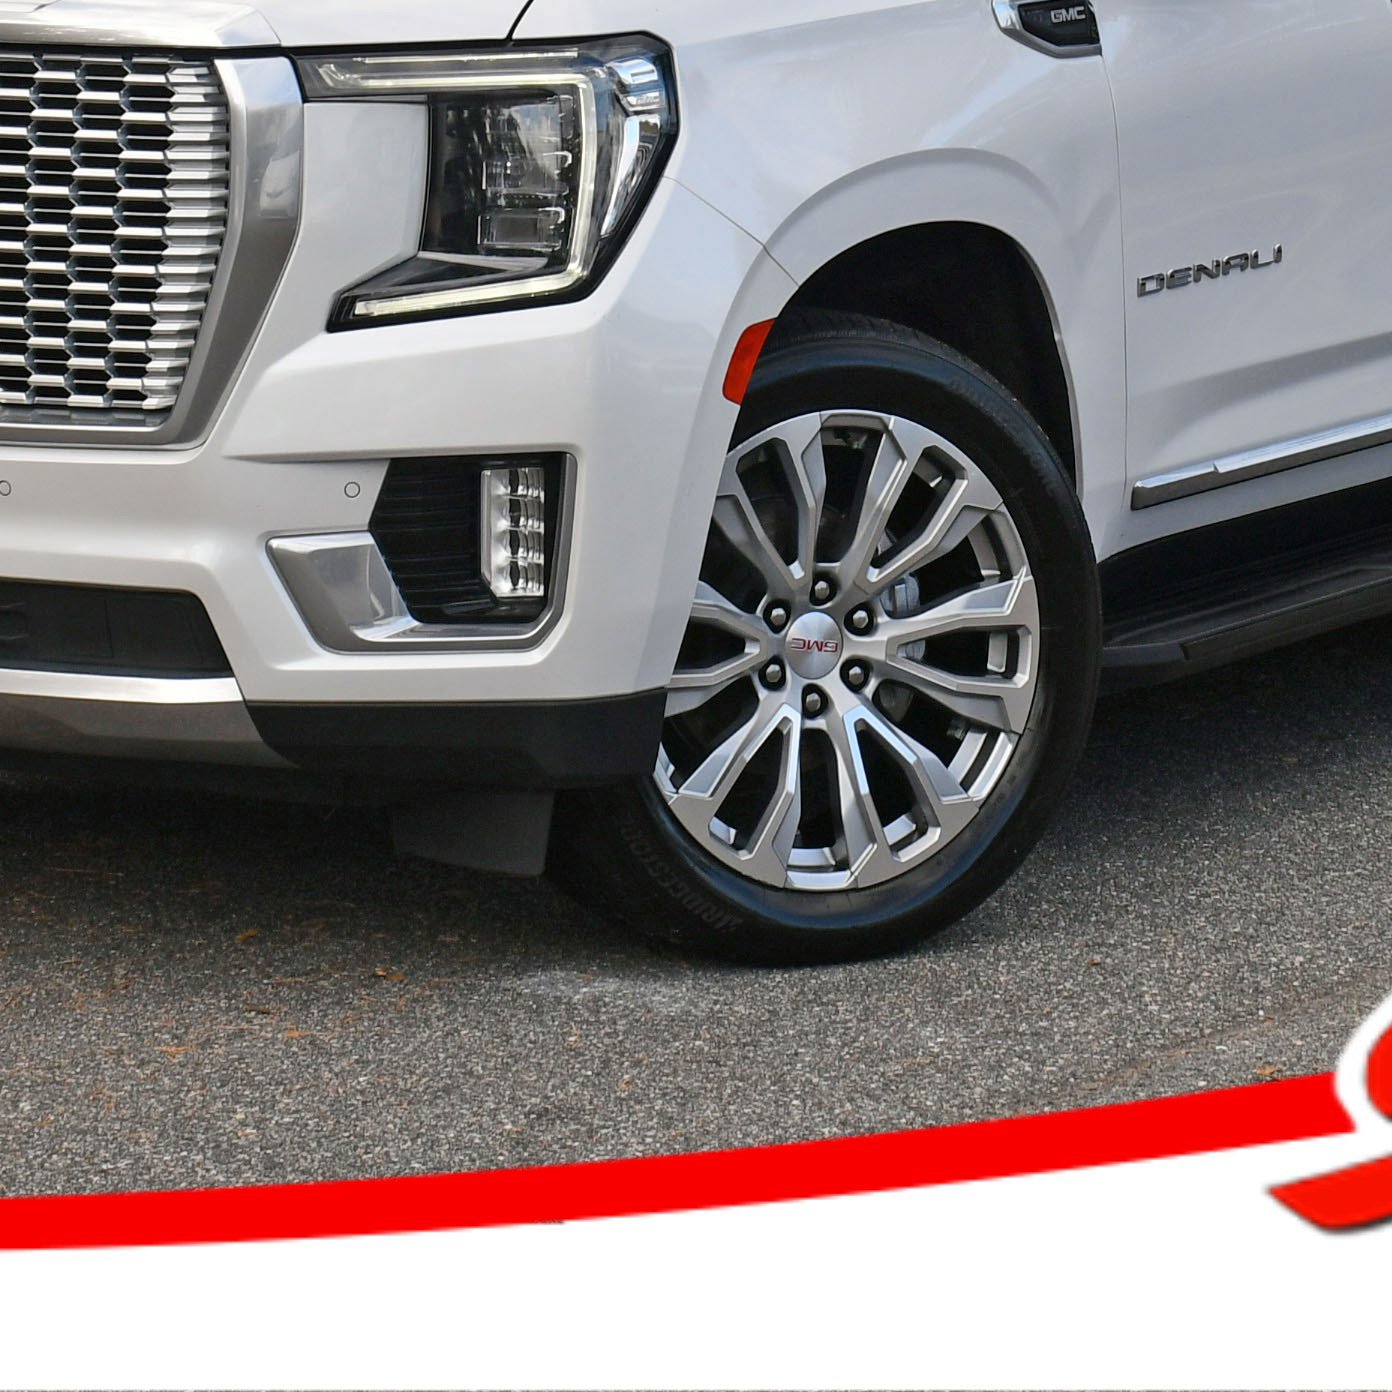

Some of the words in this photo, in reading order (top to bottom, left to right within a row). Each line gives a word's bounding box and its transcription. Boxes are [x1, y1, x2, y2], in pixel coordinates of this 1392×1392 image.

[1050, 5, 1086, 23] GMC
[1137, 243, 1282, 297] DENALI
[790, 637, 839, 653] GMC
